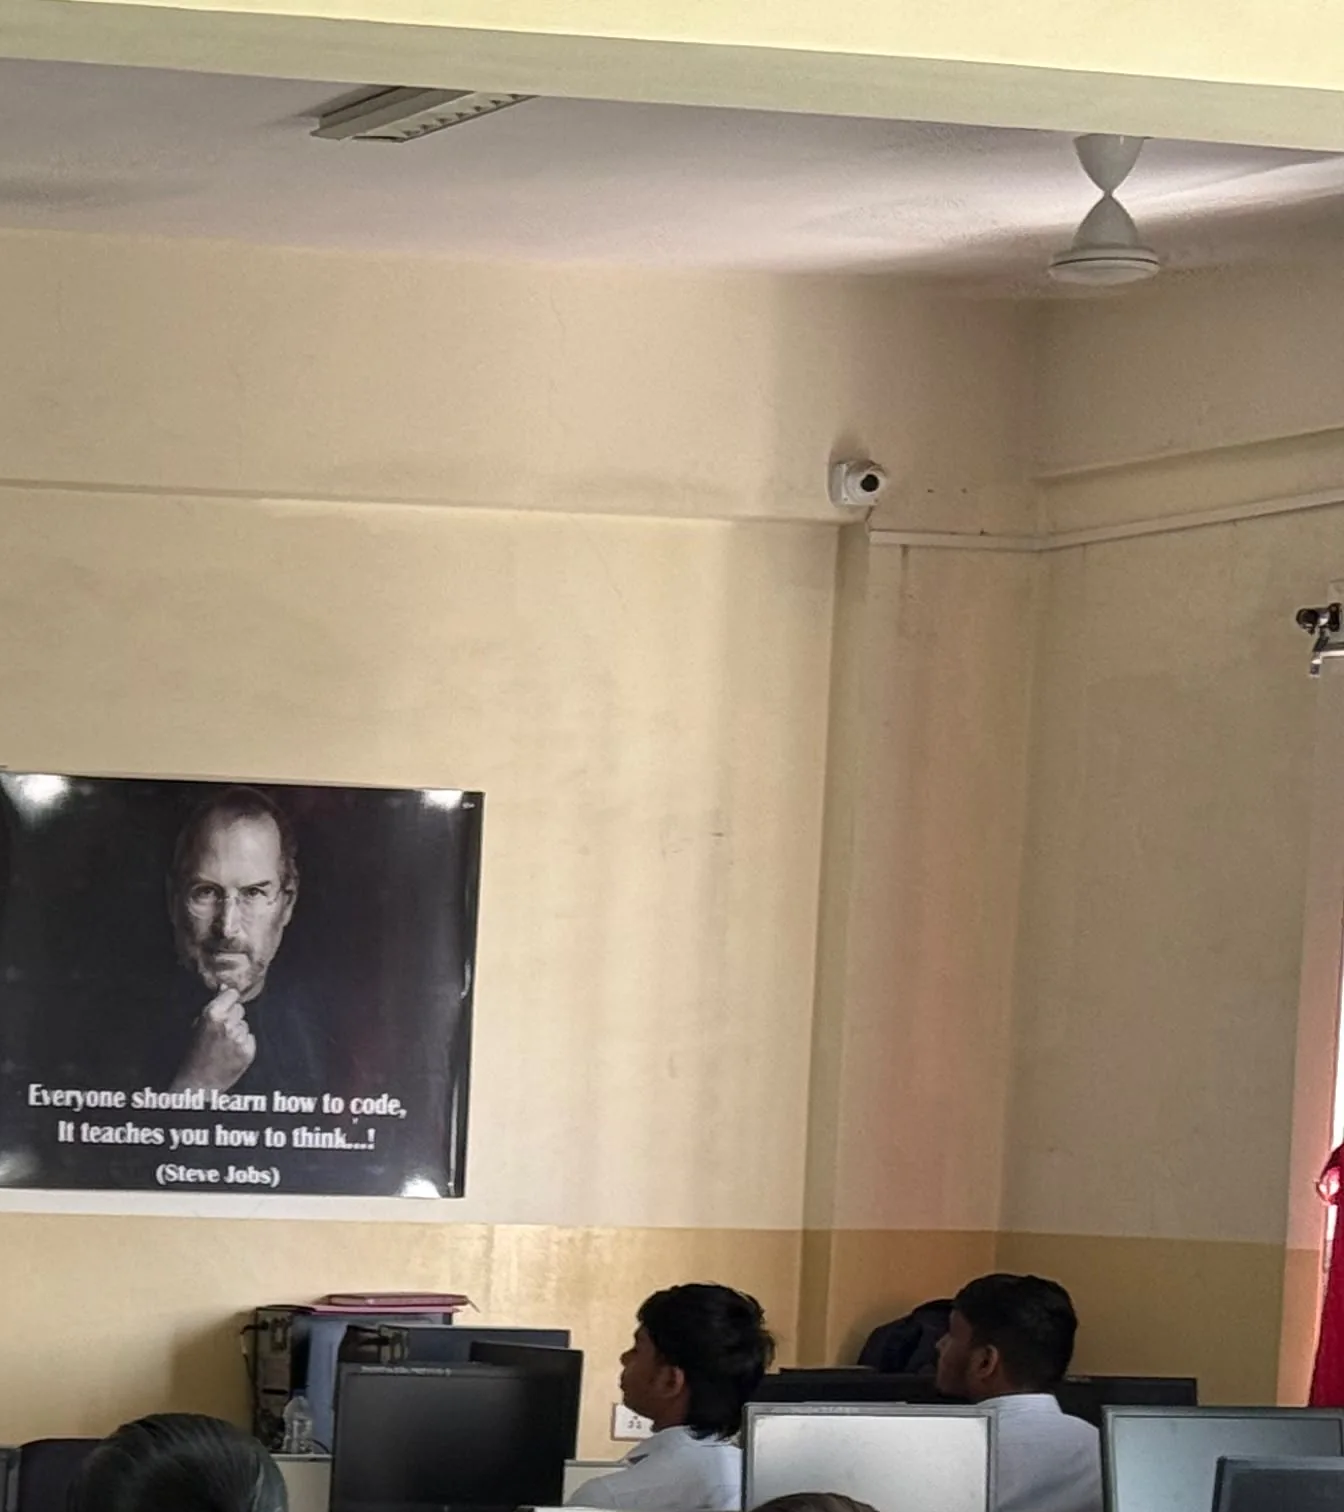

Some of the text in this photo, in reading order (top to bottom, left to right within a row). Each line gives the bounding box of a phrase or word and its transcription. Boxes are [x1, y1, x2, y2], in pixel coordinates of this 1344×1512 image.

[28, 1083, 408, 1119] Everyone should learn how to code,
[58, 1120, 74, 1142] It
[80, 1121, 165, 1145] teaches
[169, 1128, 210, 1150] you
[215, 1124, 260, 1147] how
[265, 1127, 287, 1148] to
[156, 1163, 281, 1188] (Steve Jobs)
